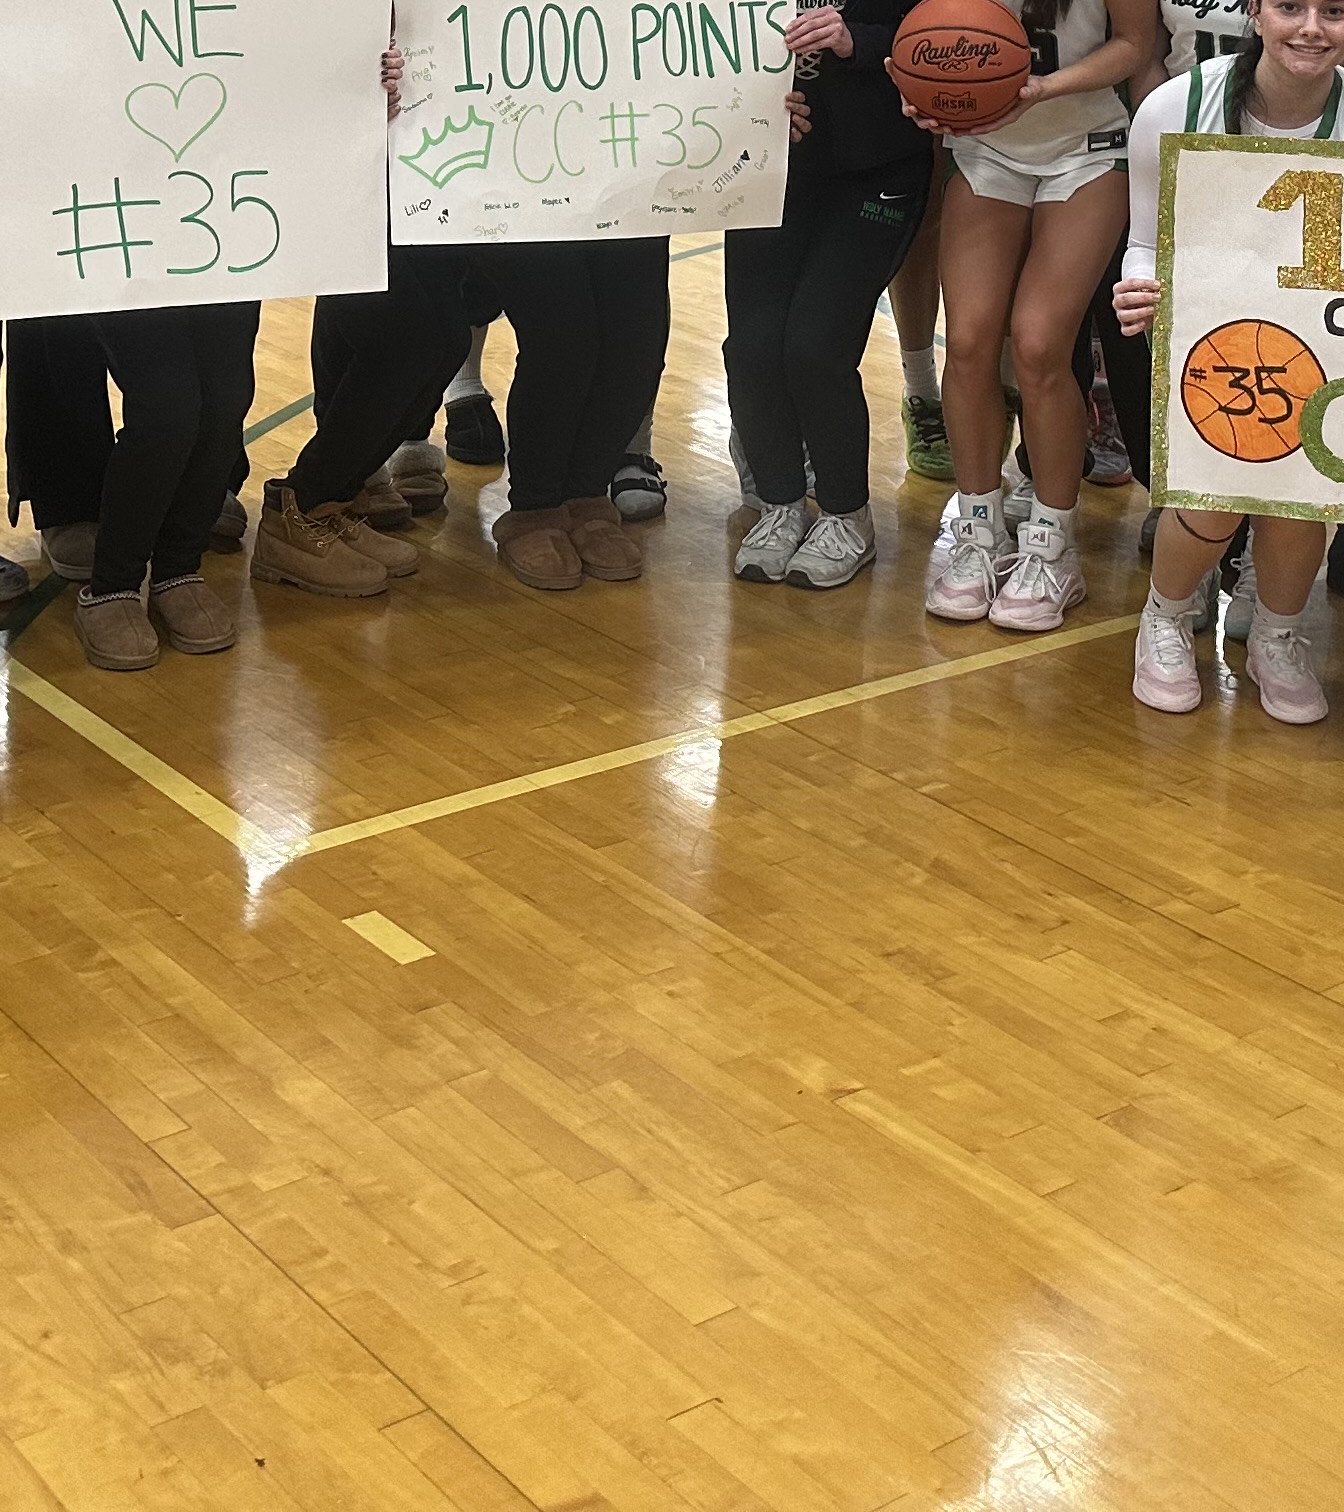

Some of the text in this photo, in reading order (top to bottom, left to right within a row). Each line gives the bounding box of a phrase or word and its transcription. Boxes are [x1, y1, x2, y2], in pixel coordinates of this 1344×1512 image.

[447, 2, 606, 97] 1,000
[912, 36, 1000, 69] Rawlings
[933, 98, 975, 110] OHSAA
[512, 99, 723, 184] CC #35
[52, 169, 281, 279] #35
[1188, 364, 1293, 425] #35
